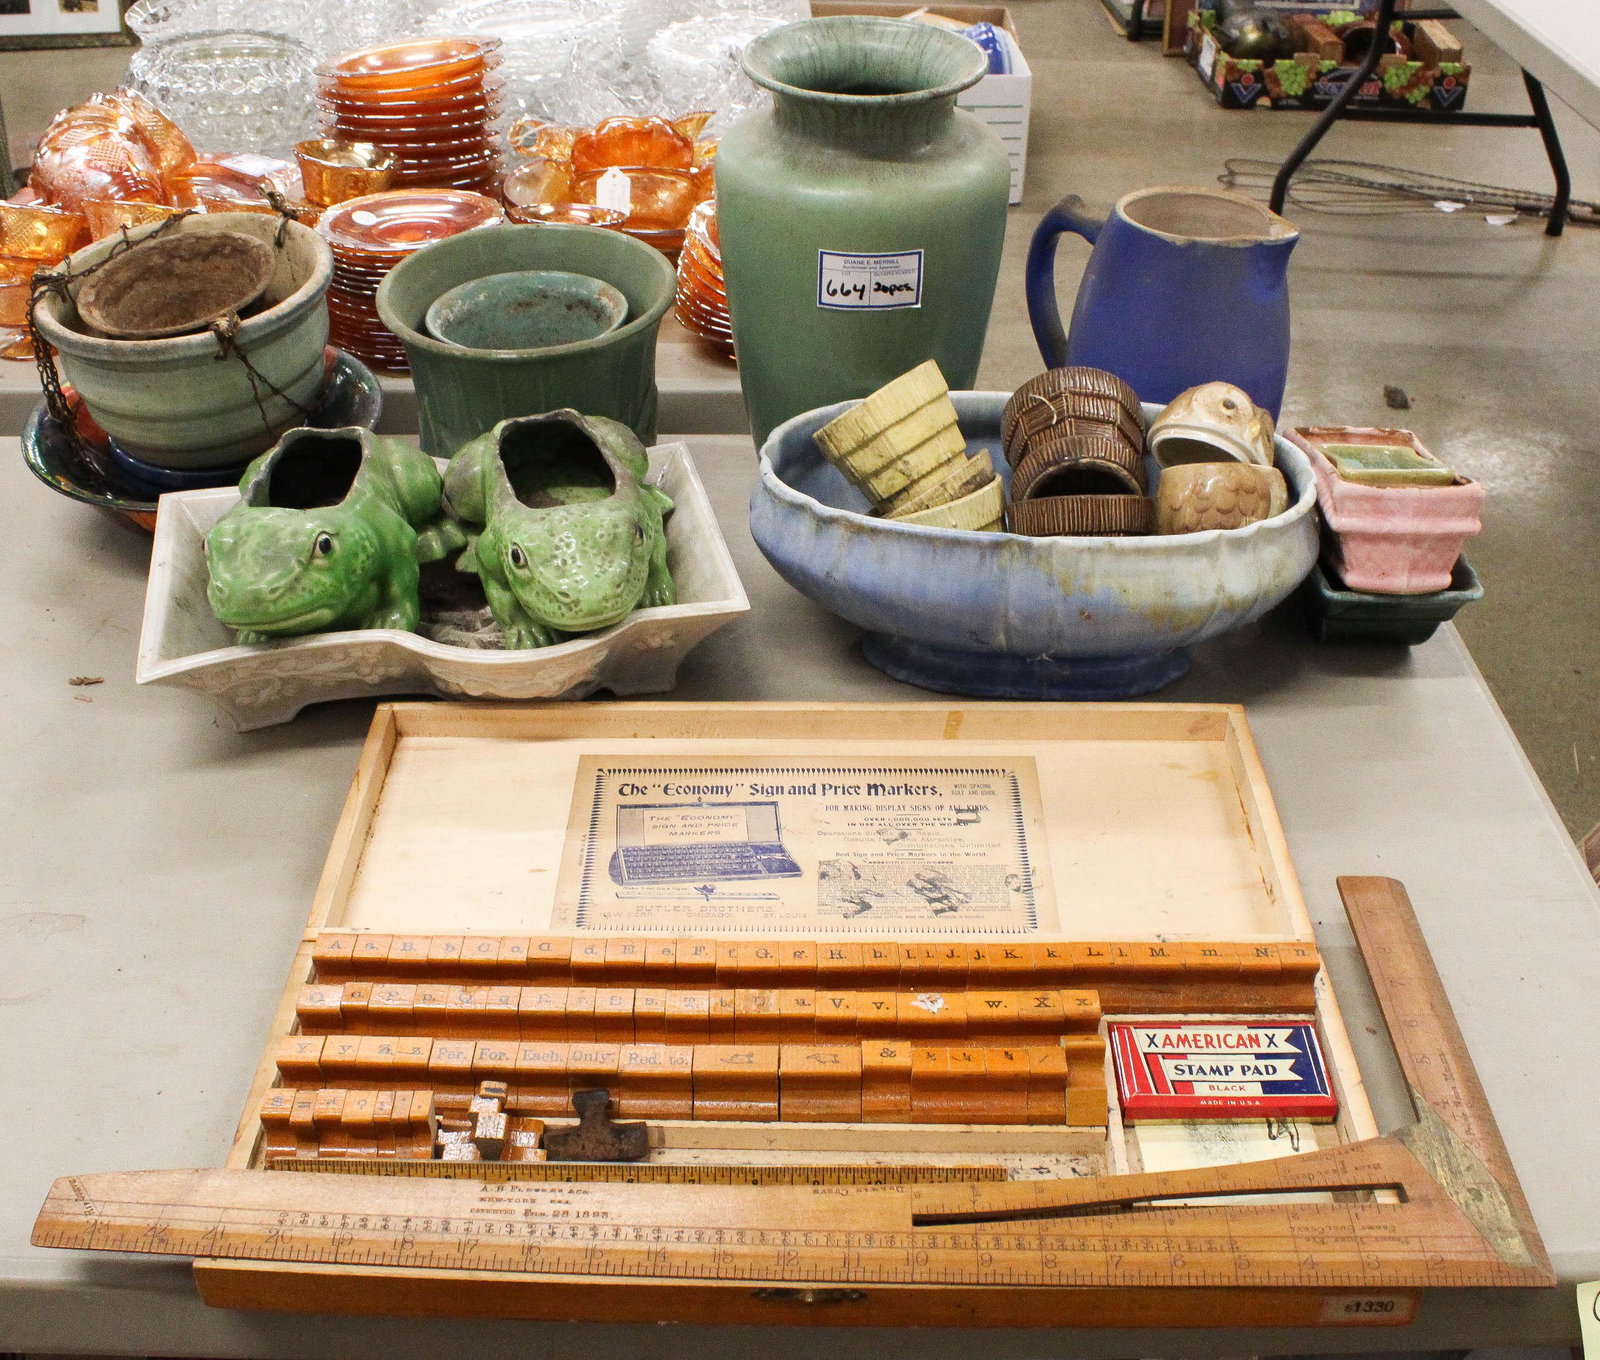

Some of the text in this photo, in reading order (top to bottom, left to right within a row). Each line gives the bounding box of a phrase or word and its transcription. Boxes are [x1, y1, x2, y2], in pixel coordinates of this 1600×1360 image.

[826, 279, 866, 300] 664
[618, 783, 943, 797] The "Economy" Sign and Price Markers,
[1145, 1033, 1279, 1049] X AMERICAN X
[1174, 1064, 1278, 1076] STAMP PAD
[1208, 1084, 1247, 1092] BLACK
